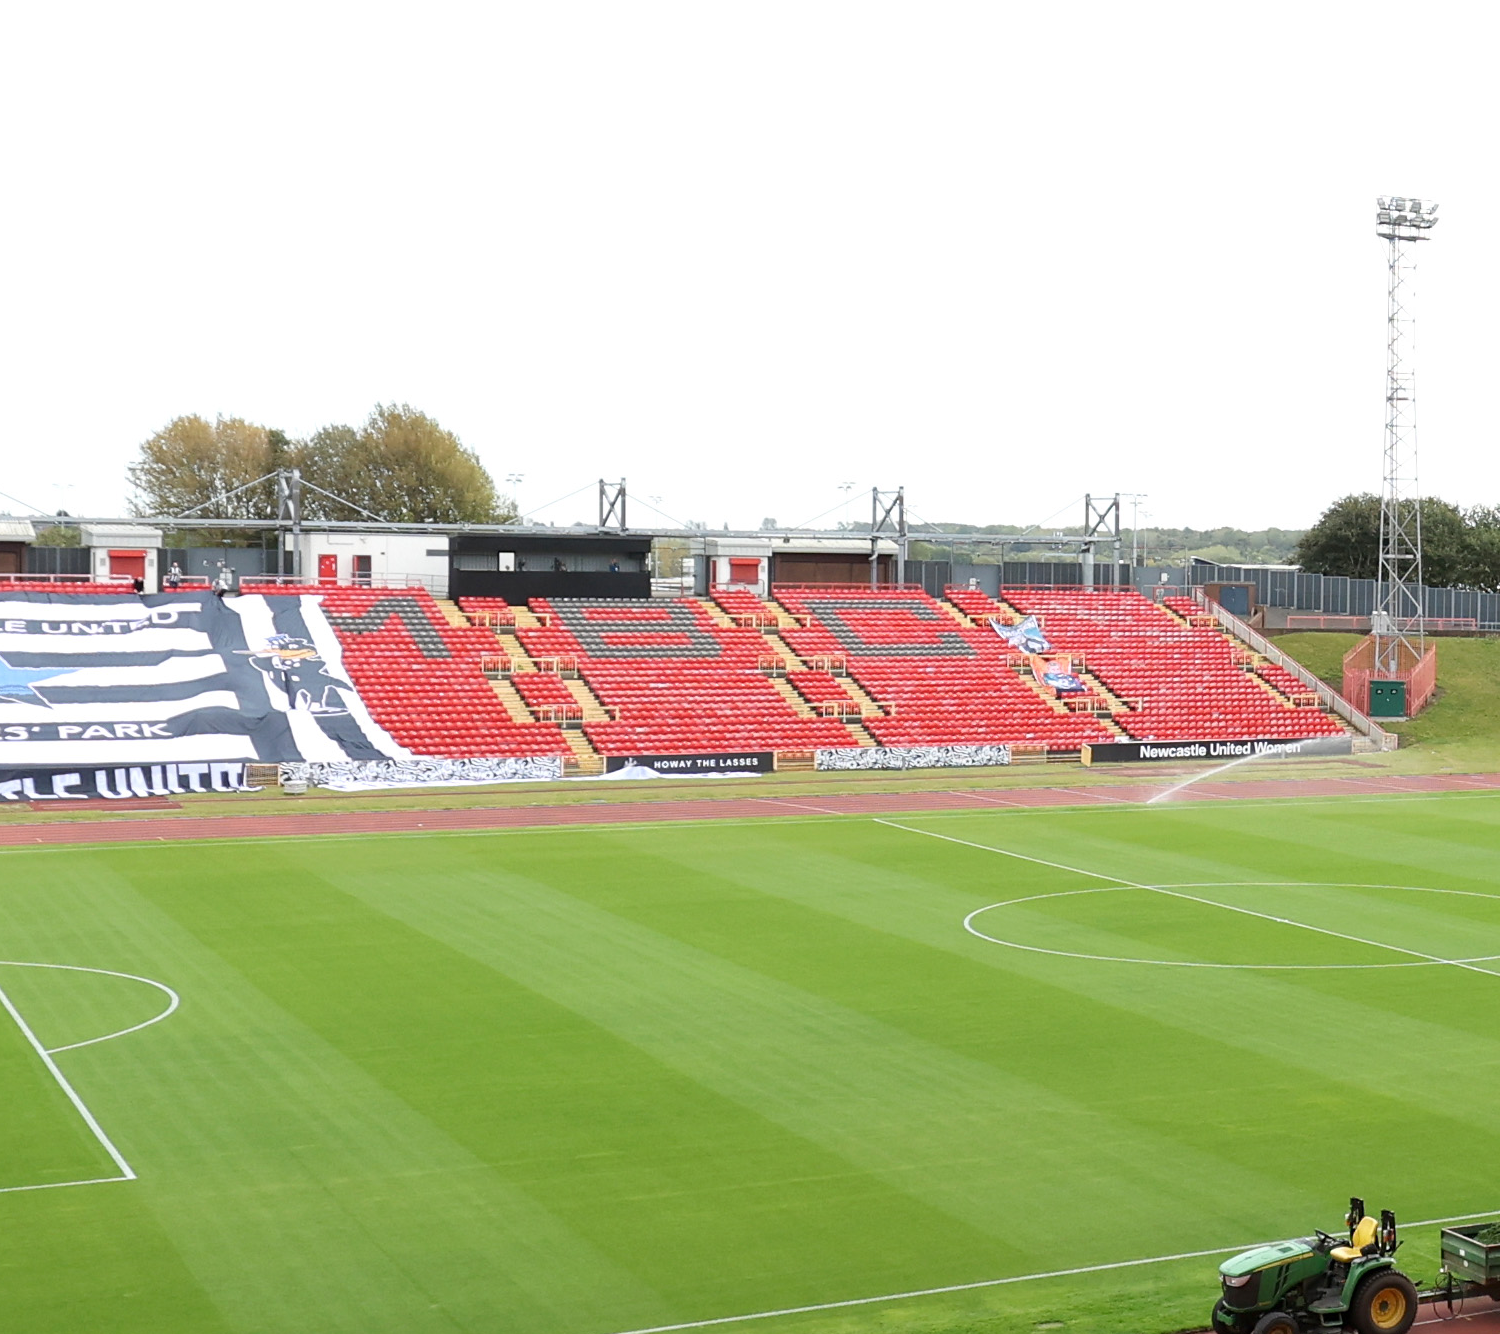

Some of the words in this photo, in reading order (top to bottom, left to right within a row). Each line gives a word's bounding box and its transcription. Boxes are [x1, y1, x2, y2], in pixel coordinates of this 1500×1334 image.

[58, 721, 174, 739] PARK
[1139, 744, 1207, 760] Newcastle
[1211, 742, 1252, 757] United
[1254, 741, 1301, 756] Women
[653, 759, 692, 770] HOWAY
[695, 758, 712, 769] THE
[715, 757, 759, 768] LASSES
